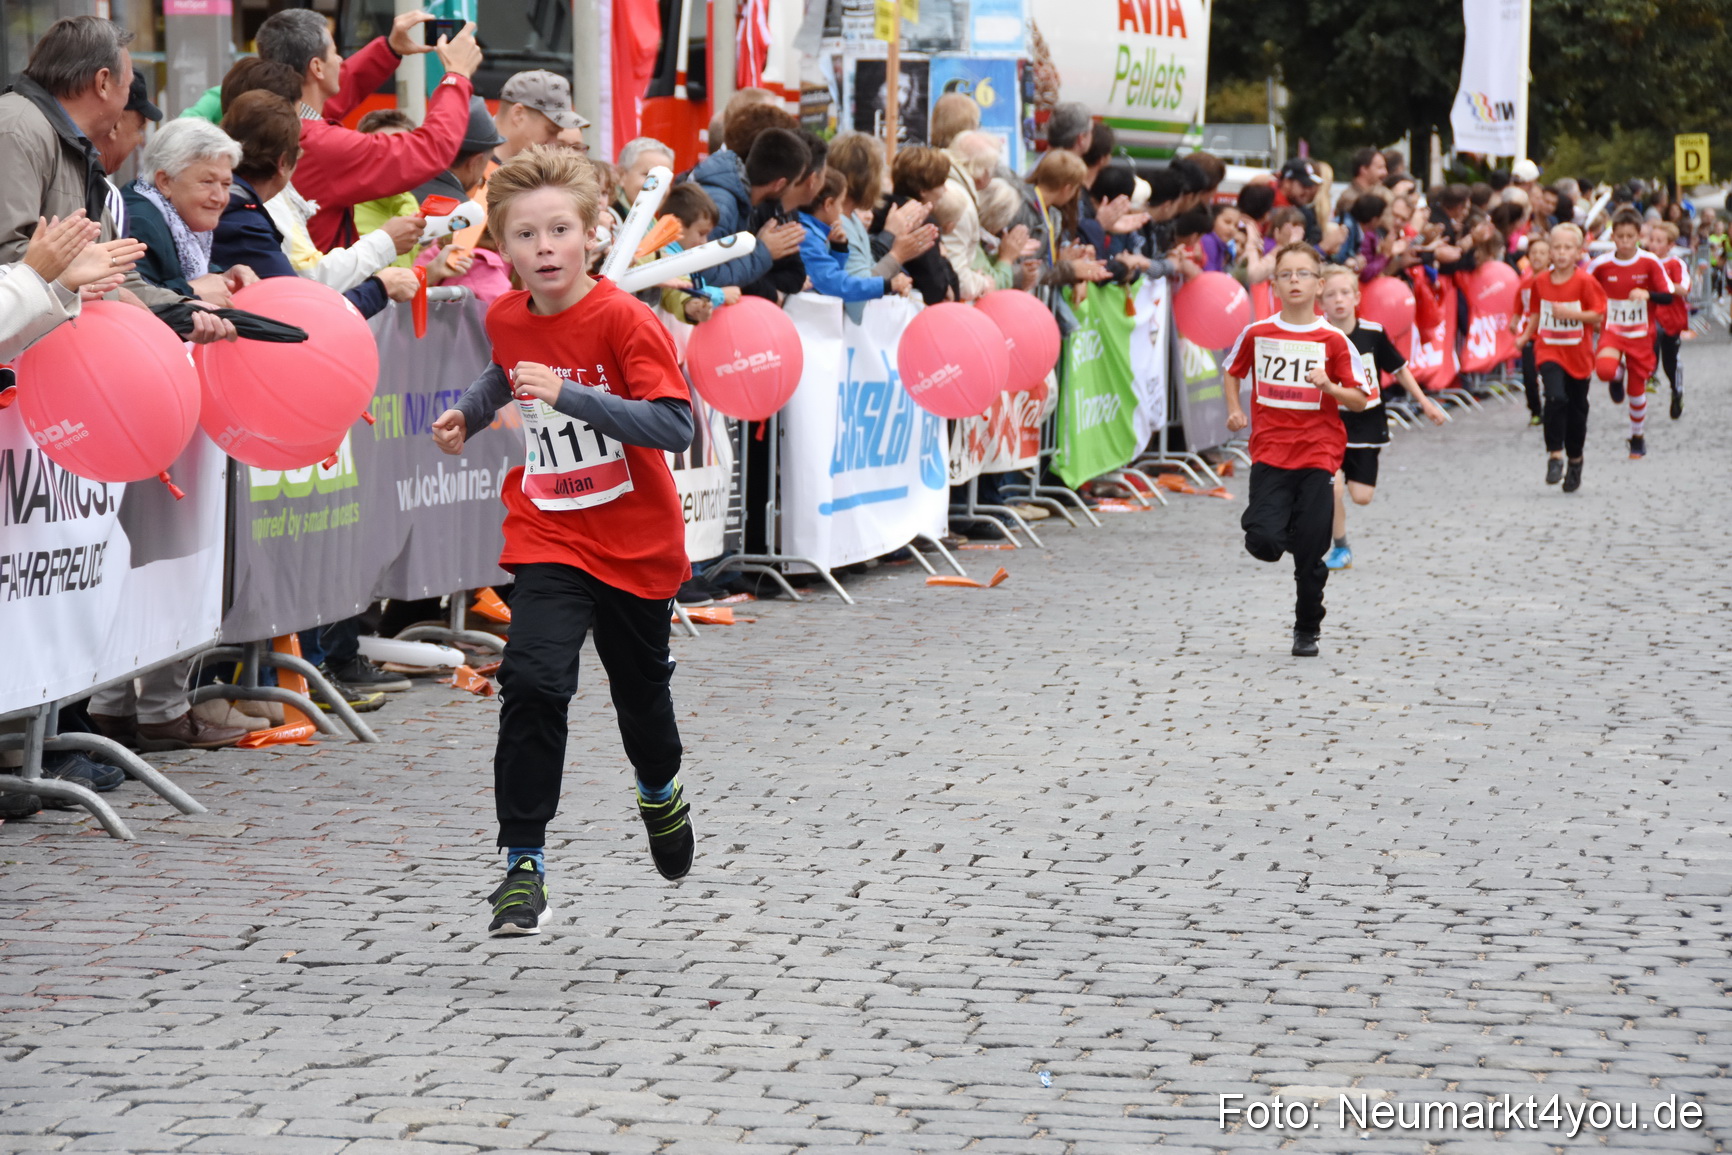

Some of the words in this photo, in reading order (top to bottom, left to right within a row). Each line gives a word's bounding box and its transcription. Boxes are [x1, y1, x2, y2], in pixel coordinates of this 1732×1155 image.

[1118, 0, 1187, 39] AVIA
[1107, 43, 1186, 109] Pellets
[1685, 150, 1700, 172] D
[1612, 309, 1643, 323] 7141
[1262, 354, 1318, 384] 7215
[1268, 387, 1303, 400] Bogdan
[553, 476, 594, 496] Julian
